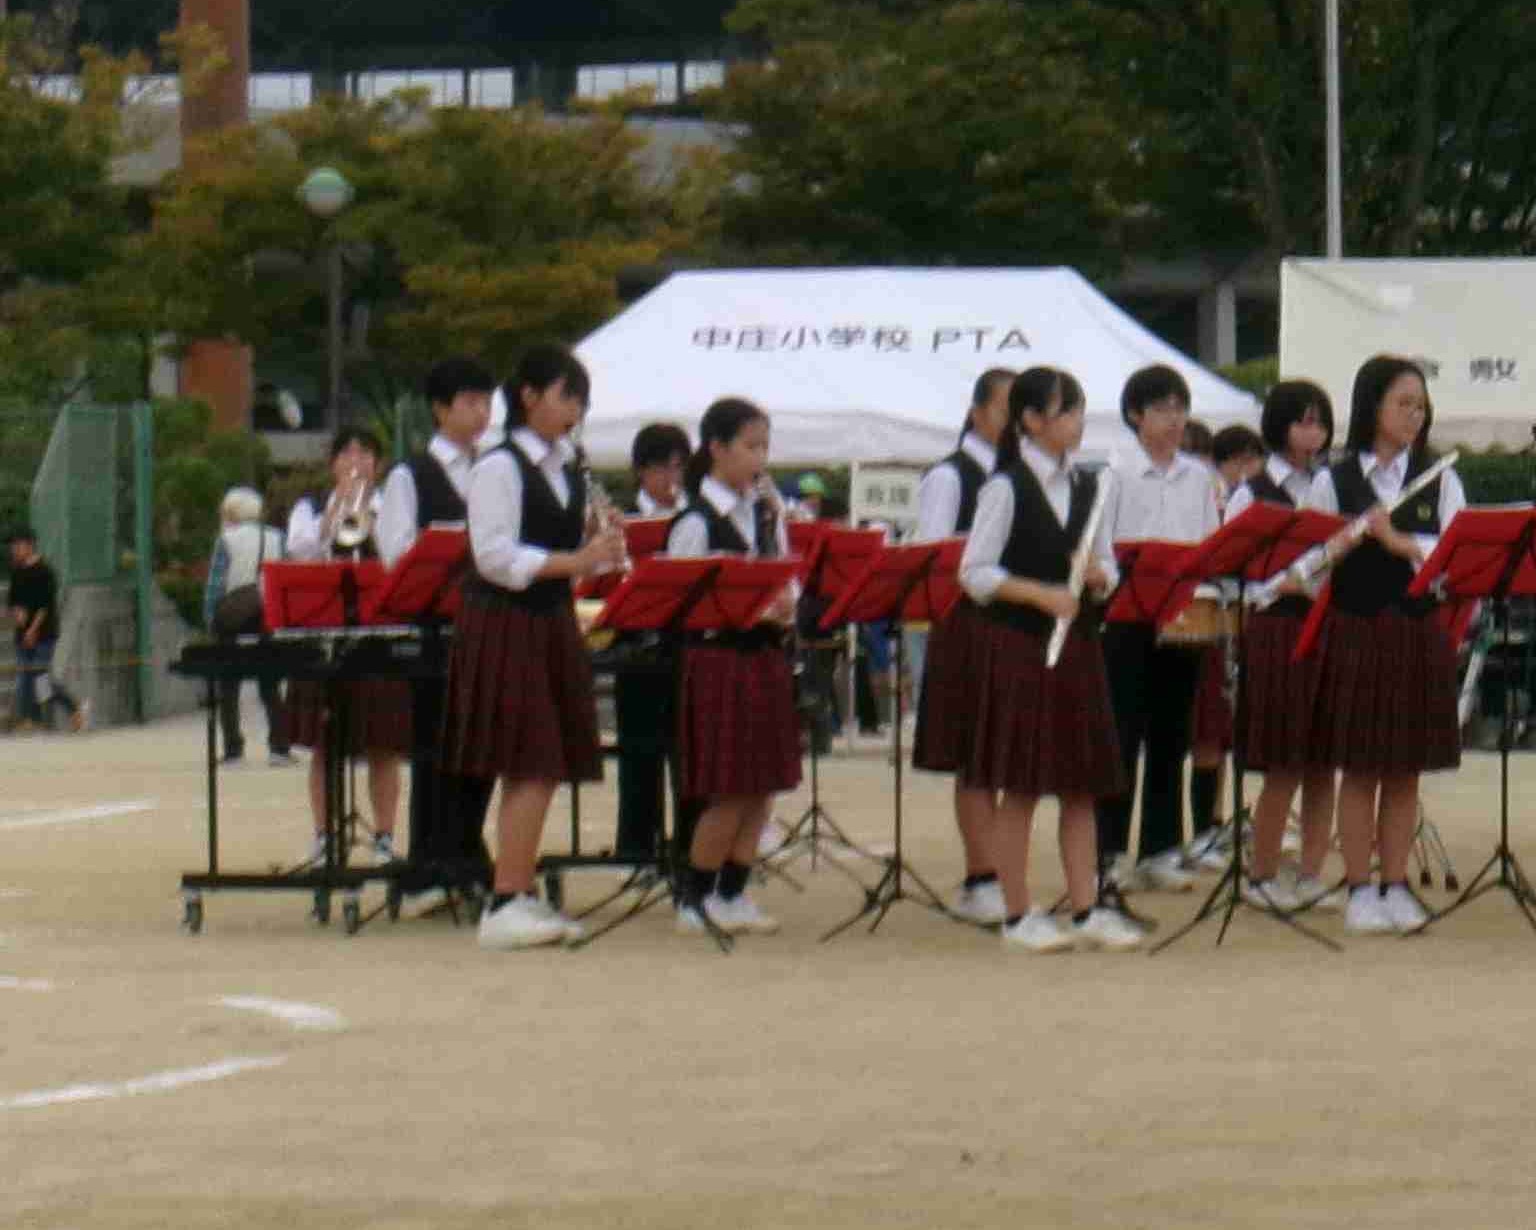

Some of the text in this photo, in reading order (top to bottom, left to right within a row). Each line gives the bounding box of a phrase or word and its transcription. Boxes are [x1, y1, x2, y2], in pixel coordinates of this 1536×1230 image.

[691, 325, 1031, 354] 中庄小学校 PTA
